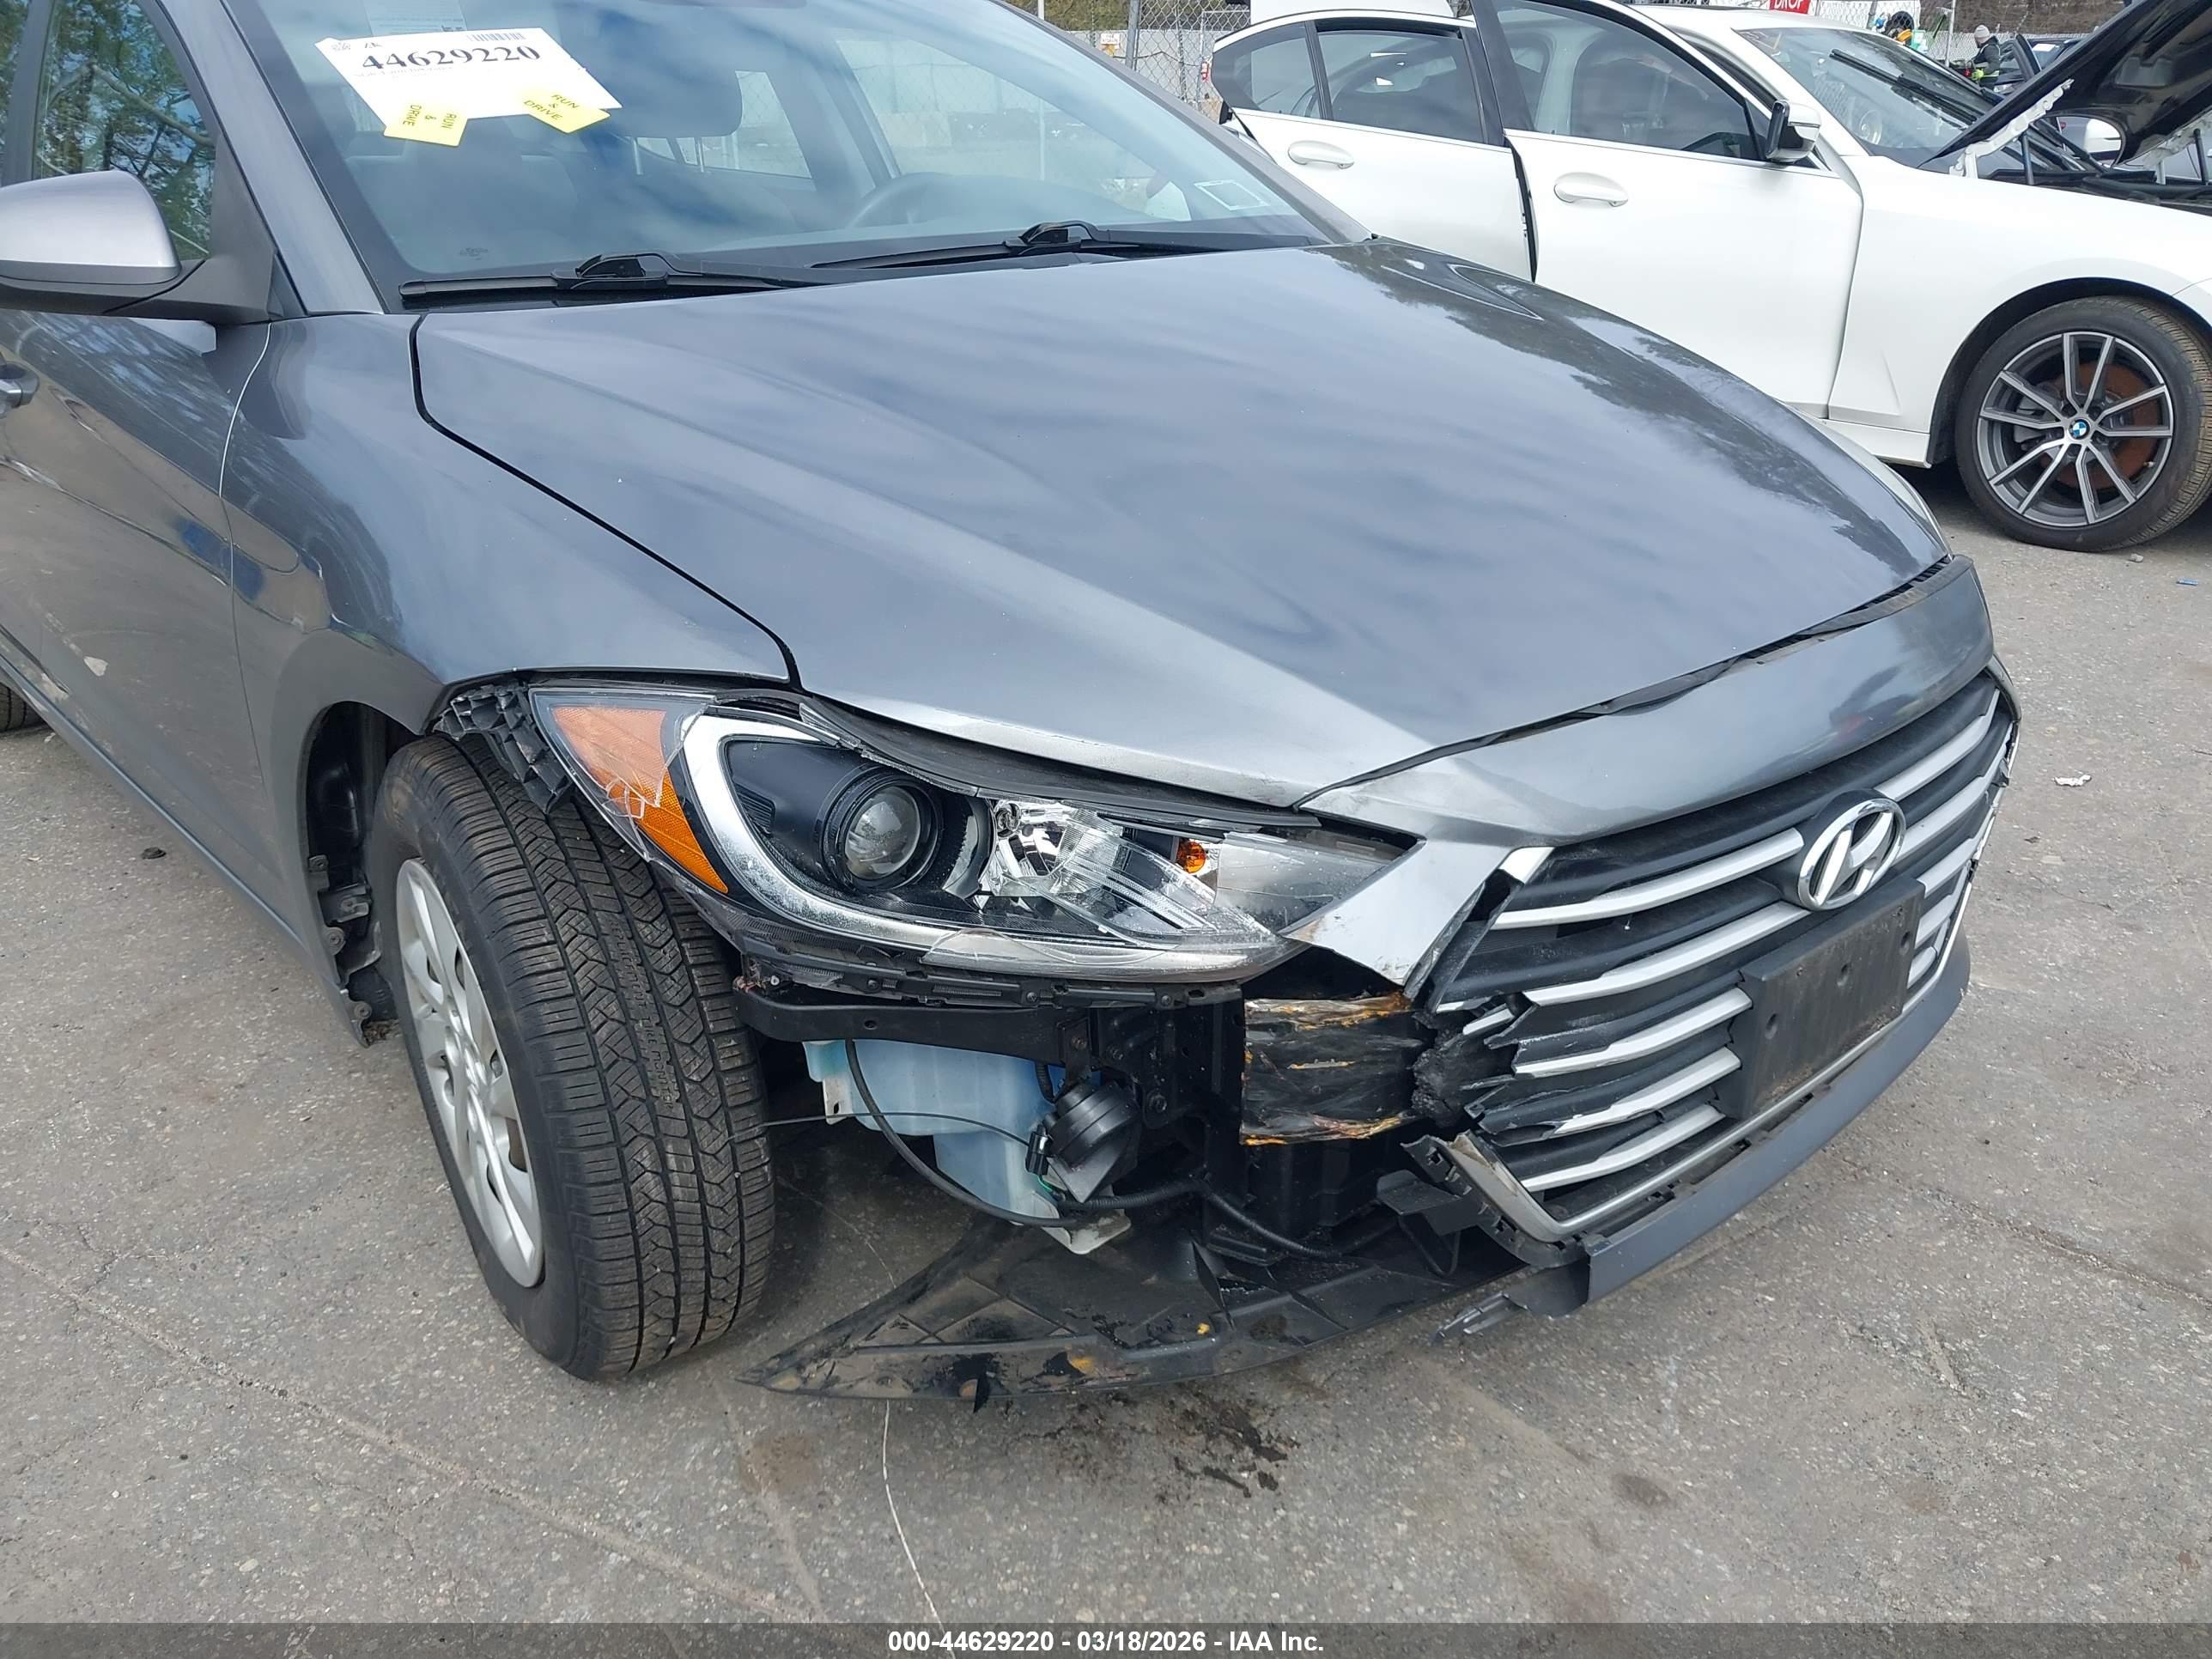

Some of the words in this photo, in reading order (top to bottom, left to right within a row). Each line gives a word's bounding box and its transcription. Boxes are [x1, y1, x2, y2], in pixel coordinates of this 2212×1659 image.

[362, 46, 540, 69] 44629220
[523, 100, 562, 120] DRIVE
[551, 94, 580, 109] RUN
[403, 105, 422, 126] DRIVE
[441, 112, 457, 130] RUN
[641, 1016, 658, 1044] TIRE
[651, 1050, 674, 1109] MONITOR
